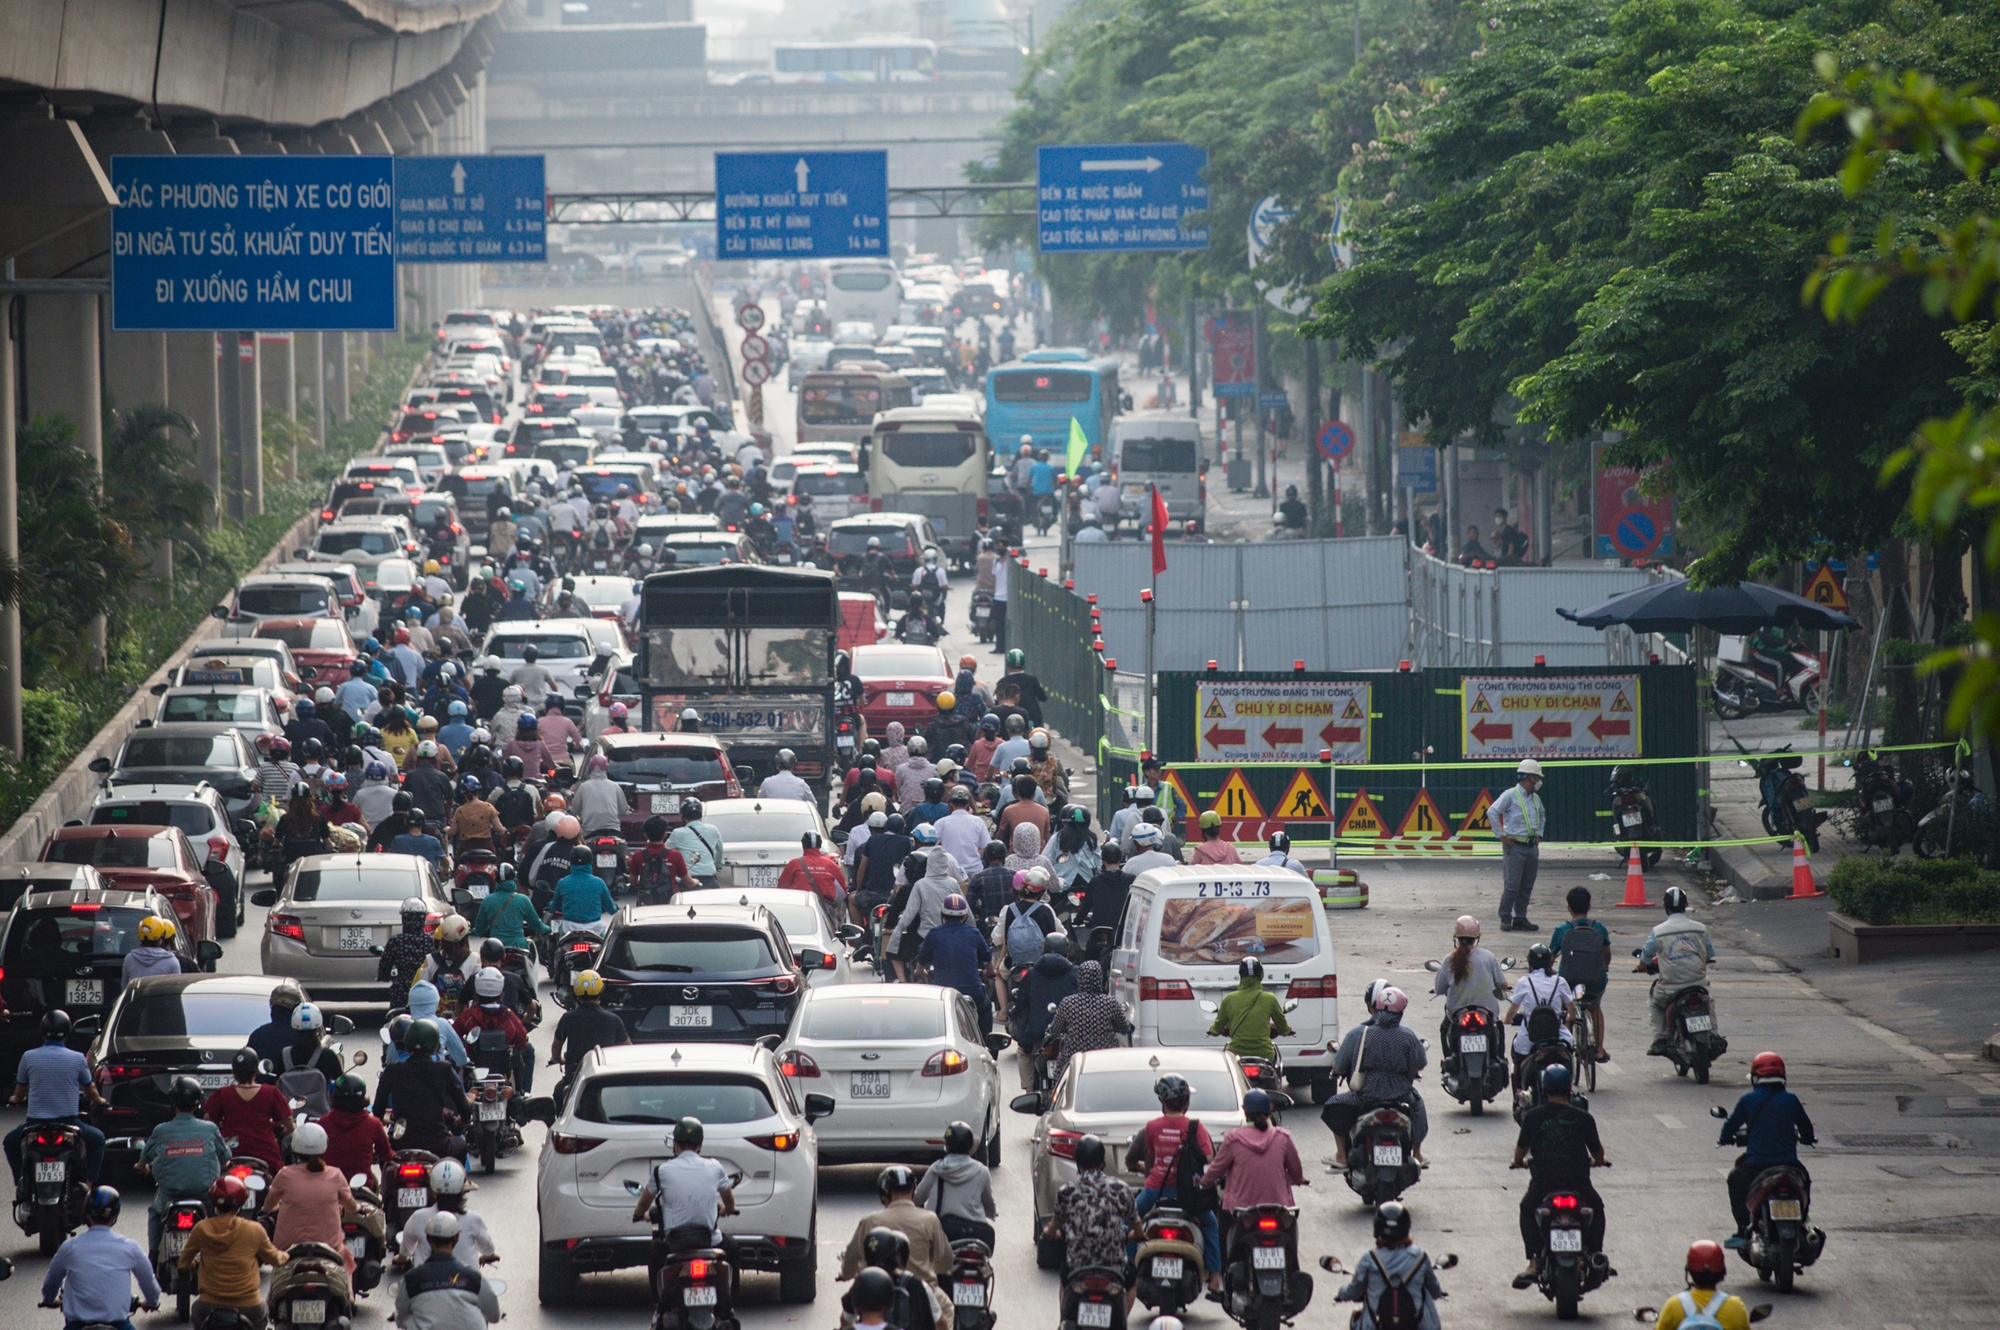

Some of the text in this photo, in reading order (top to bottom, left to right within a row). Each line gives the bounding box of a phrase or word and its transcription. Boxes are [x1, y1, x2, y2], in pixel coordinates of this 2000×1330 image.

[116, 178, 391, 212] CÁC PHƯƠNG TIỆN XE CƠ GIỚI
[1040, 183, 1062, 200] BẾN
[1066, 186, 1078, 200] XE
[1081, 183, 1110, 200] NƯỚC
[1190, 184, 1206, 198] km
[763, 190, 796, 206] KHUẤT
[800, 194, 819, 206] DUY
[824, 189, 848, 206] TIẾN
[525, 198, 542, 210] km
[1042, 209, 1062, 222] CAO
[1064, 204, 1084, 222] TỐC
[1085, 204, 1112, 222] PHÁP
[526, 220, 542, 232] km
[724, 212, 746, 230] BẾN
[750, 216, 762, 230] XE
[863, 214, 880, 228] km
[115, 231, 133, 256] ĐI
[138, 227, 176, 256] NGÃ
[180, 230, 206, 256] TƯ
[210, 223, 238, 257] SỞ,
[244, 222, 304, 256] KHUẤT
[310, 232, 346, 256] DUY
[351, 222, 392, 256] TIẾN
[1042, 230, 1062, 244] CAO
[1064, 226, 1084, 244] TỐC
[1085, 227, 1099, 242] HÀ
[1143, 228, 1176, 242] PHÒNG
[526, 240, 542, 254] km
[786, 236, 814, 250] LONG
[864, 236, 880, 248] km
[156, 270, 352, 303] ĐI XUỐNG HẦM CHUI
[1477, 680, 1622, 692] CÔNG TRƯỜNG ĐANG THI CÔNG
[1212, 686, 1354, 697] CÔNG TRƯỜNG ĐANG THI CÔNG
[1501, 695, 1528, 708] CHÚ
[1533, 694, 1541, 708] Ý
[1546, 697, 1558, 708] ĐI
[1234, 701, 1263, 714] CHÚ
[1267, 700, 1276, 714] Ý
[1278, 703, 1292, 714] ĐI
[702, 712, 784, 727] 29H-532.01
[1492, 746, 1516, 754] Chúng
[1224, 751, 1248, 760] Chúng
[652, 804, 678, 812] 975.02
[1358, 807, 1368, 816] ĐI
[1348, 818, 1376, 830] CHẬM
[755, 868, 772, 876] 30G
[750, 878, 777, 887] 121.50
[347, 928, 364, 938] 30E
[340, 939, 372, 950] 395.26
[76, 980, 94, 992] 29A
[69, 992, 102, 1002] 138.25
[682, 1006, 700, 1016] 30K
[674, 1016, 708, 1026] 307.66
[1462, 1044, 1485, 1052] 441.33
[860, 1072, 881, 1084] 89A
[852, 1084, 889, 1096] 004.96
[1378, 1147, 1398, 1156] 20-F1
[1376, 1156, 1401, 1164] 544.57
[37, 1172, 64, 1181] 379.55
[400, 1197, 425, 1206] 504.91
[1555, 1231, 1577, 1240] 36-B6
[1552, 1240, 1580, 1250] 502.58
[1258, 1248, 1279, 1258] 19-B1
[1255, 1258, 1282, 1267] 523.12
[1152, 1268, 1180, 1278] 029.95
[958, 1286, 980, 1294] 29-U1
[956, 1294, 983, 1304] 141.77
